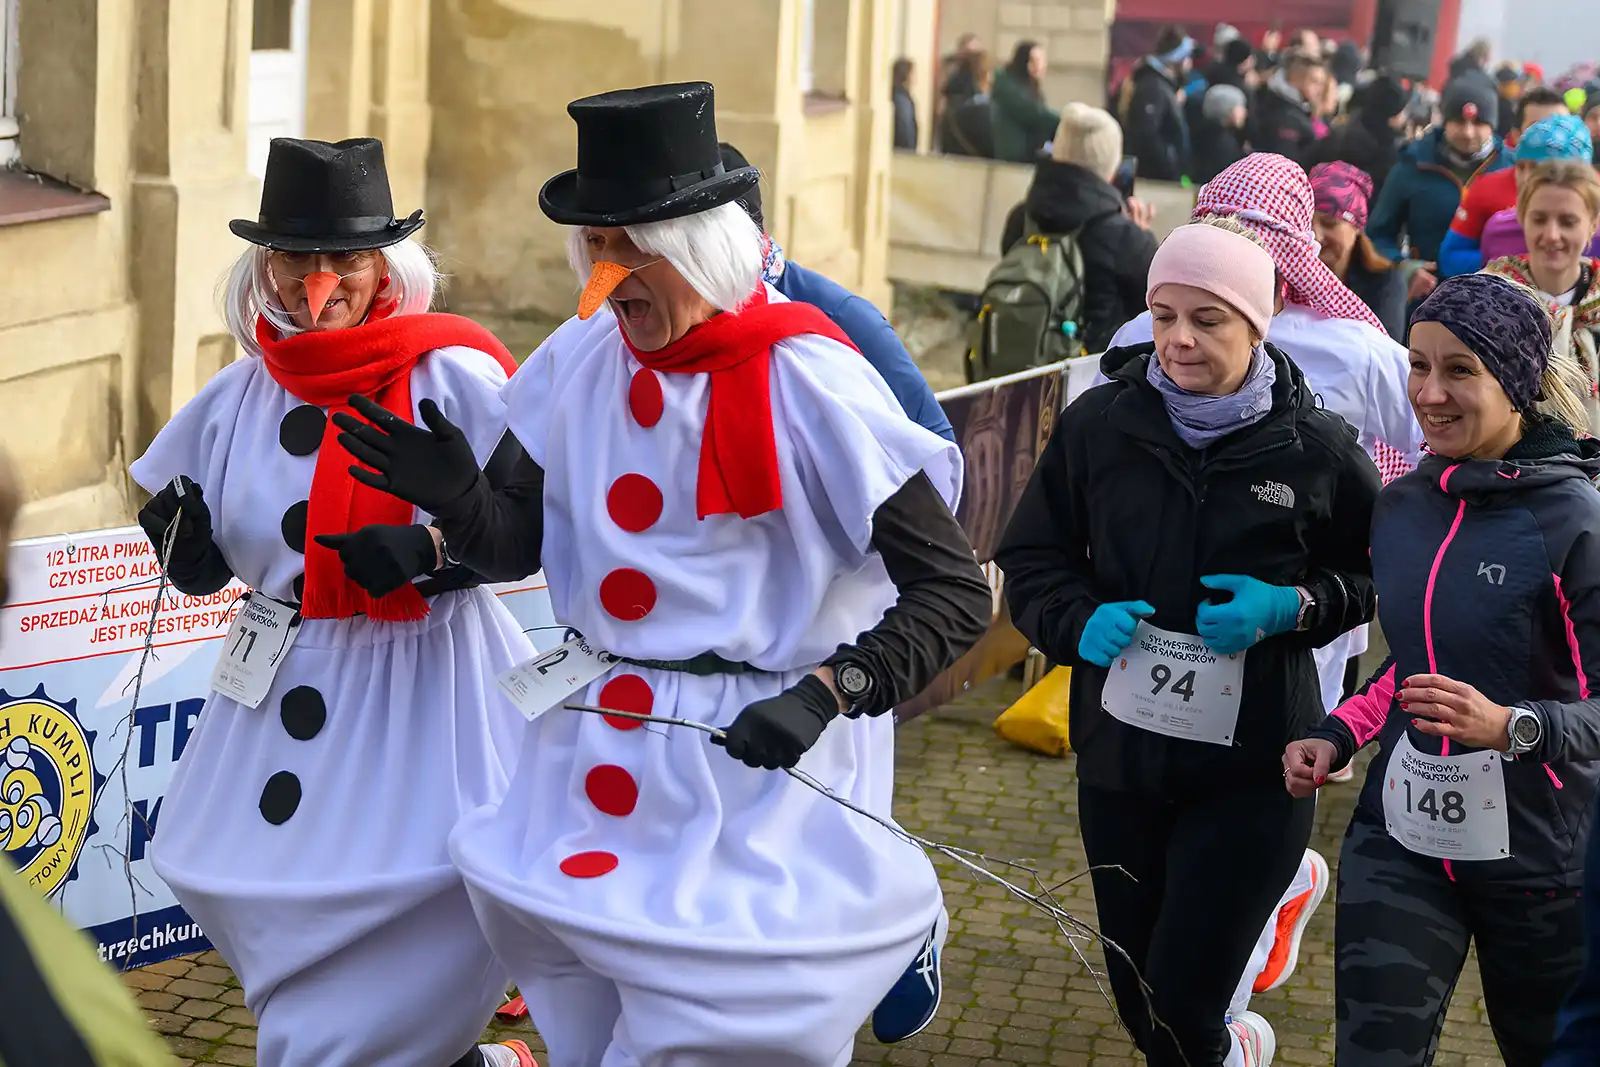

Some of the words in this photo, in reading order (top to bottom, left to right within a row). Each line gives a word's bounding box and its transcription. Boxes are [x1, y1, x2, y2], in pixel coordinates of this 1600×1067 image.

[1250, 484, 1281, 499] NORTH
[1265, 480, 1282, 491] THE
[1257, 493, 1279, 505] FACE
[46, 551, 64, 567] 1/2
[68, 546, 109, 564] LITRA
[116, 541, 149, 560] PIWA
[49, 564, 126, 589] CZYSTEGO
[20, 604, 98, 633] SPRZEDAŻ
[103, 597, 177, 621] ALKOHOLU
[90, 627, 123, 644] JEST
[230, 625, 258, 663] 71
[1148, 634, 1211, 654] SYLWESTROWY
[1158, 646, 1217, 665] SANGUSZKÓW
[1150, 663, 1197, 703] 94
[28, 713, 84, 798] KUMPLI
[1403, 778, 1467, 825] 148
[28, 843, 67, 891] FTOWY
